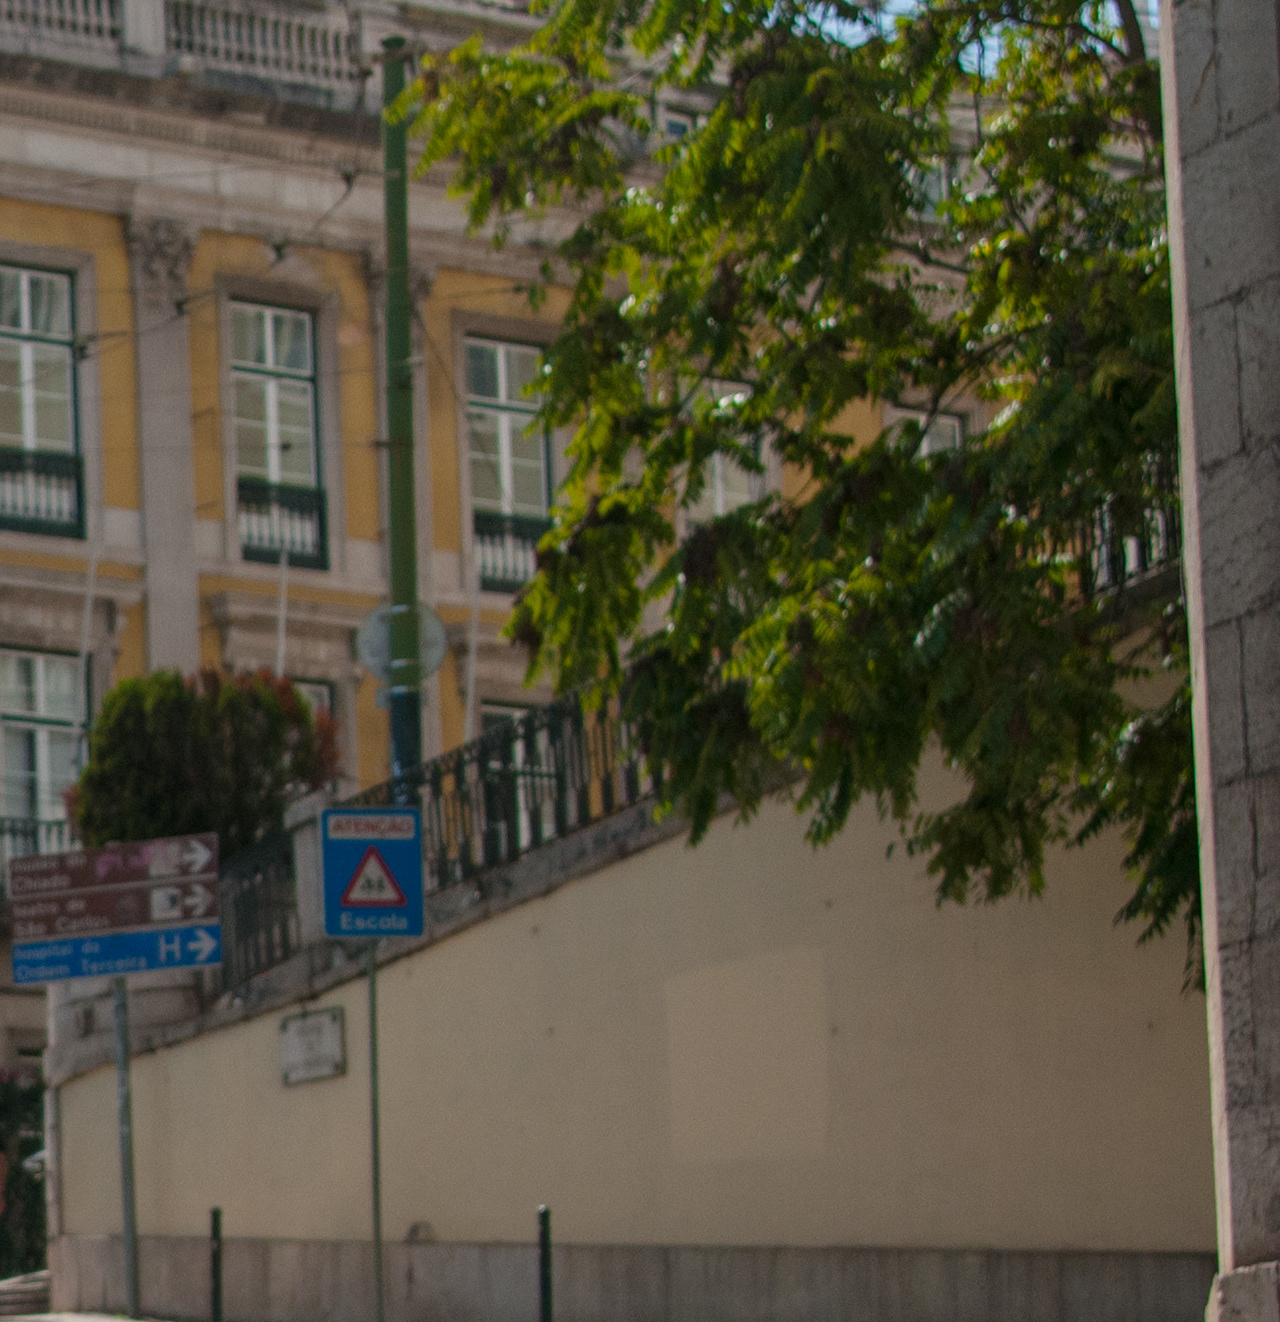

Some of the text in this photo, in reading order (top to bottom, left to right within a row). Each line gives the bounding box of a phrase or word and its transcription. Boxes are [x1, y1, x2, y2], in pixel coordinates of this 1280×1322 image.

[333, 817, 411, 835] ATENÇÃO
[14, 873, 71, 892] Chiado
[340, 911, 407, 931] Escola
[159, 935, 181, 963] H
[15, 956, 147, 981] Ordem Terceira
